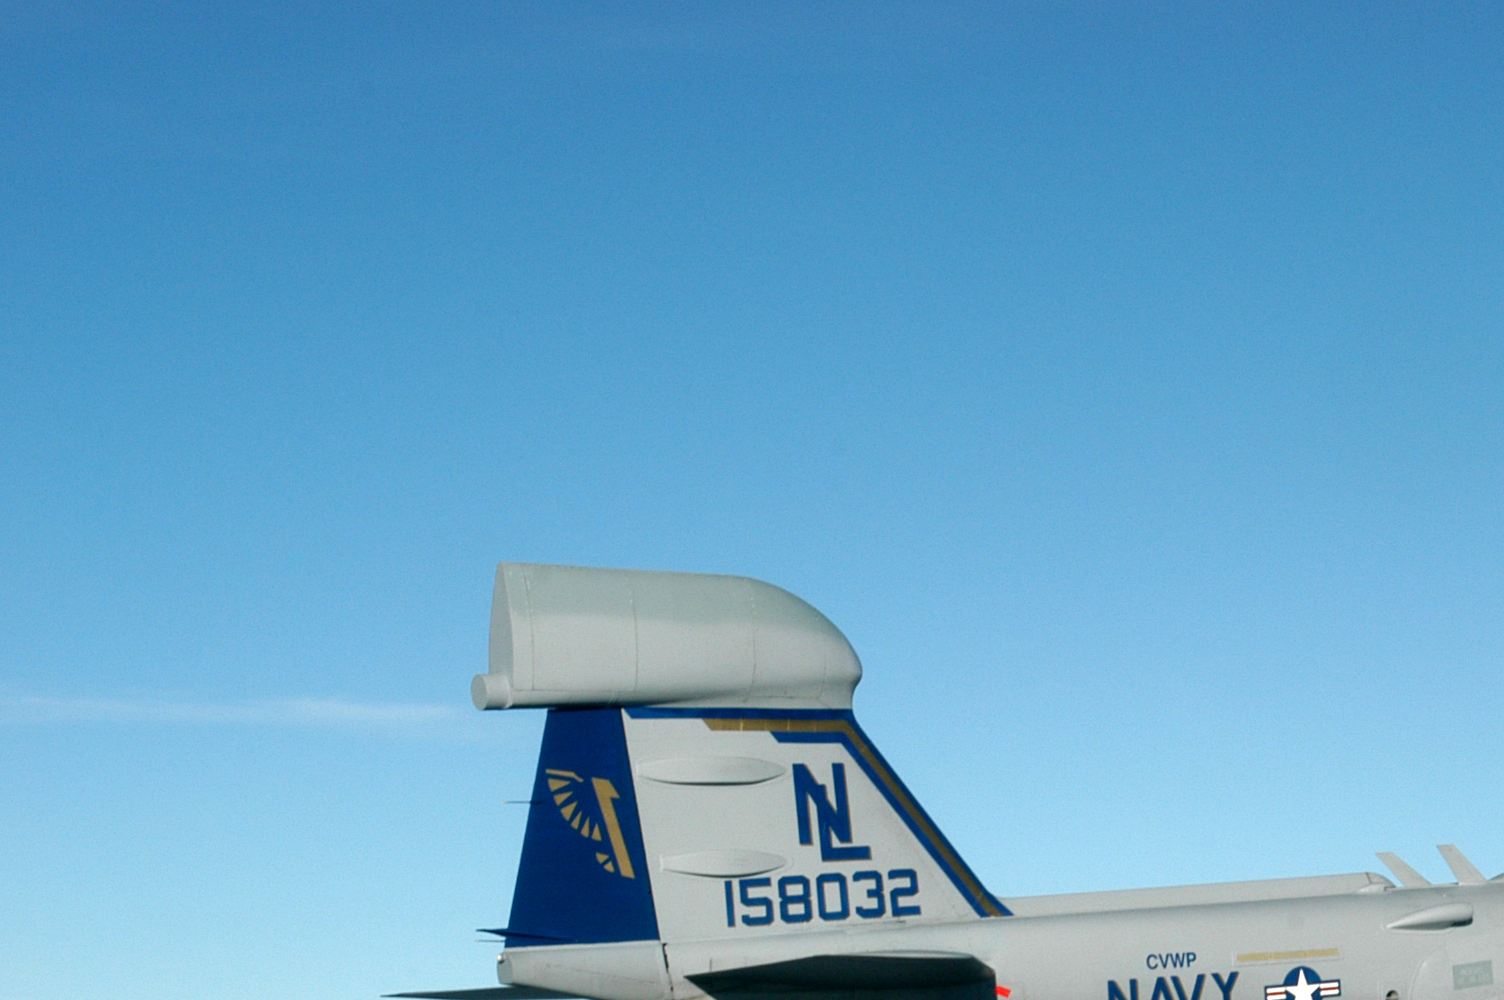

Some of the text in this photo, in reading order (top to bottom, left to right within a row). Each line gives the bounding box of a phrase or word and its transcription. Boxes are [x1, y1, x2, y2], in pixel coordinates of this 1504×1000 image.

[792, 763, 871, 862] NL
[724, 868, 921, 928] 158032
[1146, 951, 1197, 970] CVWP
